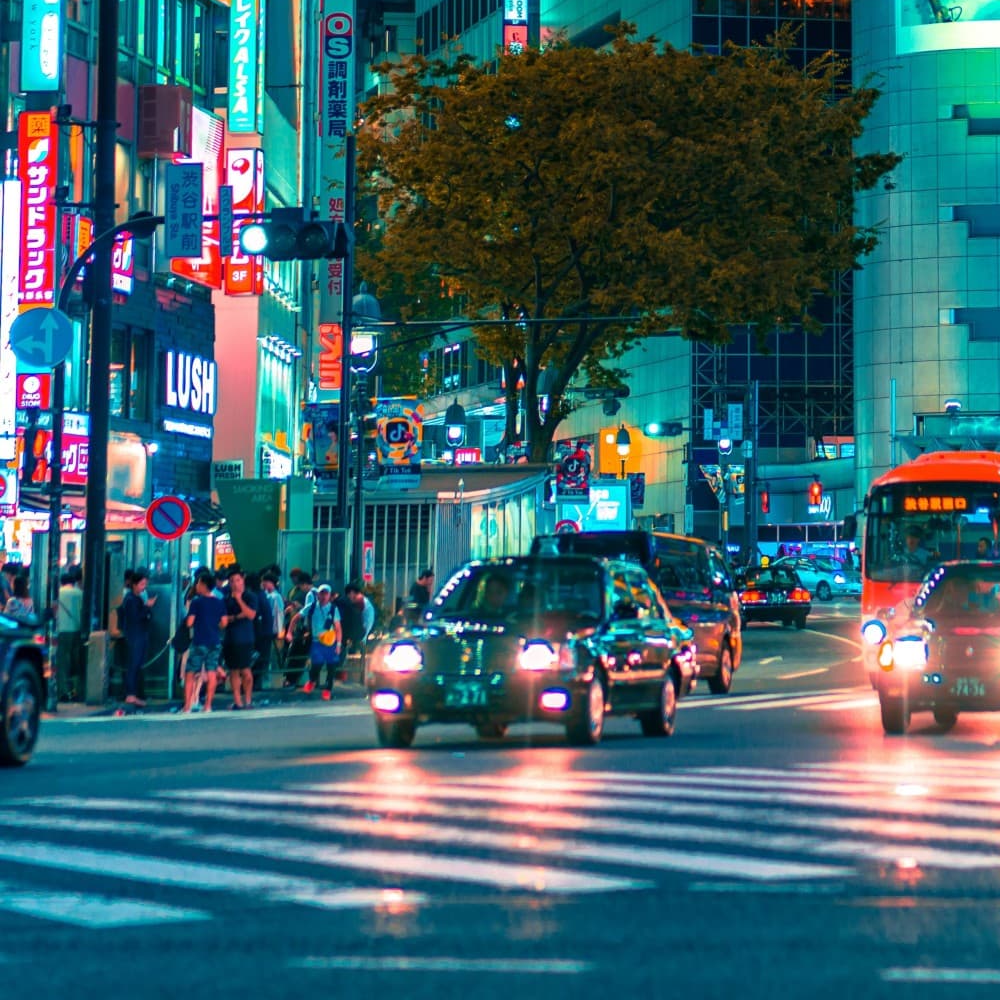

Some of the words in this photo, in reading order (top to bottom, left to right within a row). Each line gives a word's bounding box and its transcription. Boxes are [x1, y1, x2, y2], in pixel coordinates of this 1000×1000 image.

[327, 61, 348, 138] 調剤薬局
[181, 170, 199, 251] 渋谷駅前
[231, 271, 248, 282] 3F
[165, 351, 215, 414] LUSH
